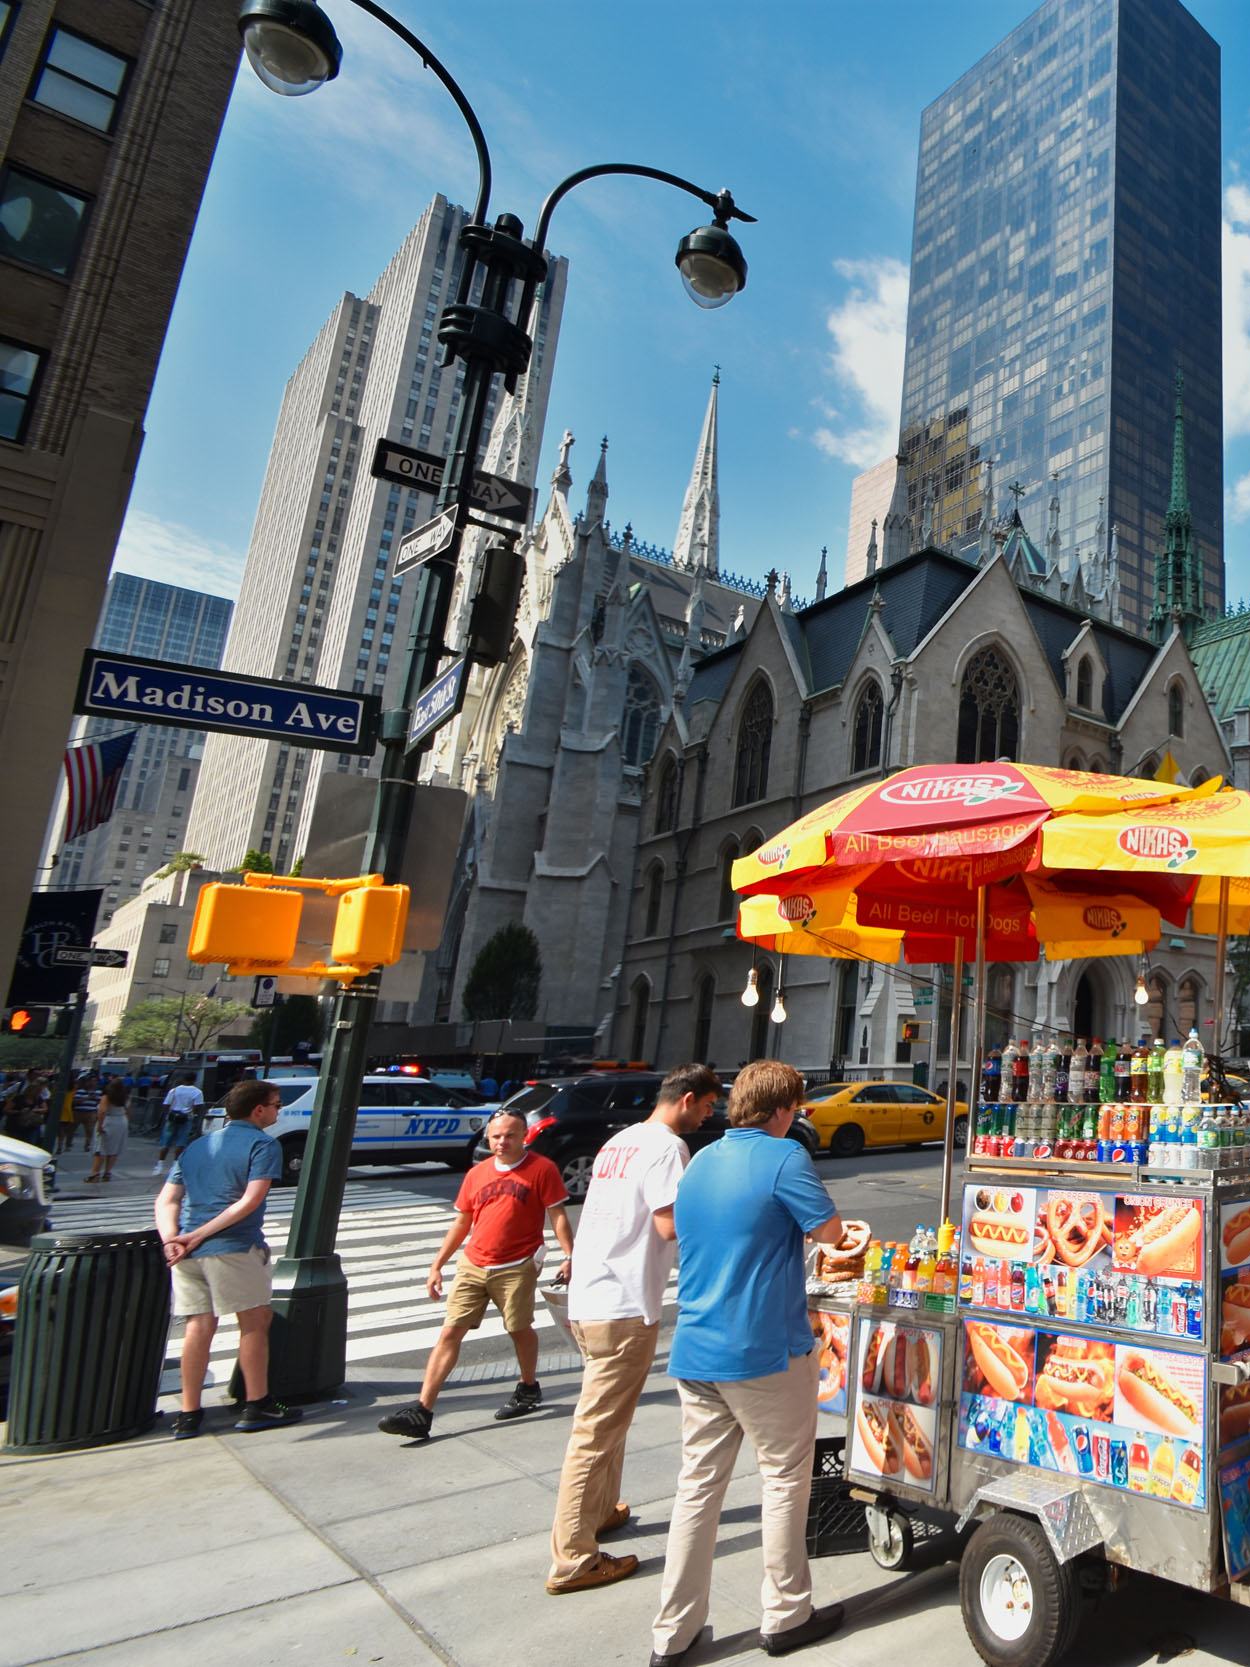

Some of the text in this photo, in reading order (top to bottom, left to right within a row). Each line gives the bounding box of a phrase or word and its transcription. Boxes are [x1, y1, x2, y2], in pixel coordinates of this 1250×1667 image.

[399, 458, 443, 484] ONE
[401, 523, 448, 561] ONE WAY
[93, 672, 356, 734] Madison Ave
[413, 705, 430, 731] East
[901, 777, 995, 800] NIKAS
[845, 834, 870, 853] All
[878, 832, 928, 850] Beef
[1127, 828, 1182, 857] NIKAS
[781, 896, 810, 918] NIKAS
[869, 902, 892, 920] All
[898, 904, 940, 924] Beef
[946, 909, 976, 929] Hot
[1086, 908, 1119, 927] NIKAS
[59, 951, 119, 962] ONE WAY
[404, 1118, 461, 1136] NYPD
[1124, 1194, 1193, 1208] ONION CRUNCH
